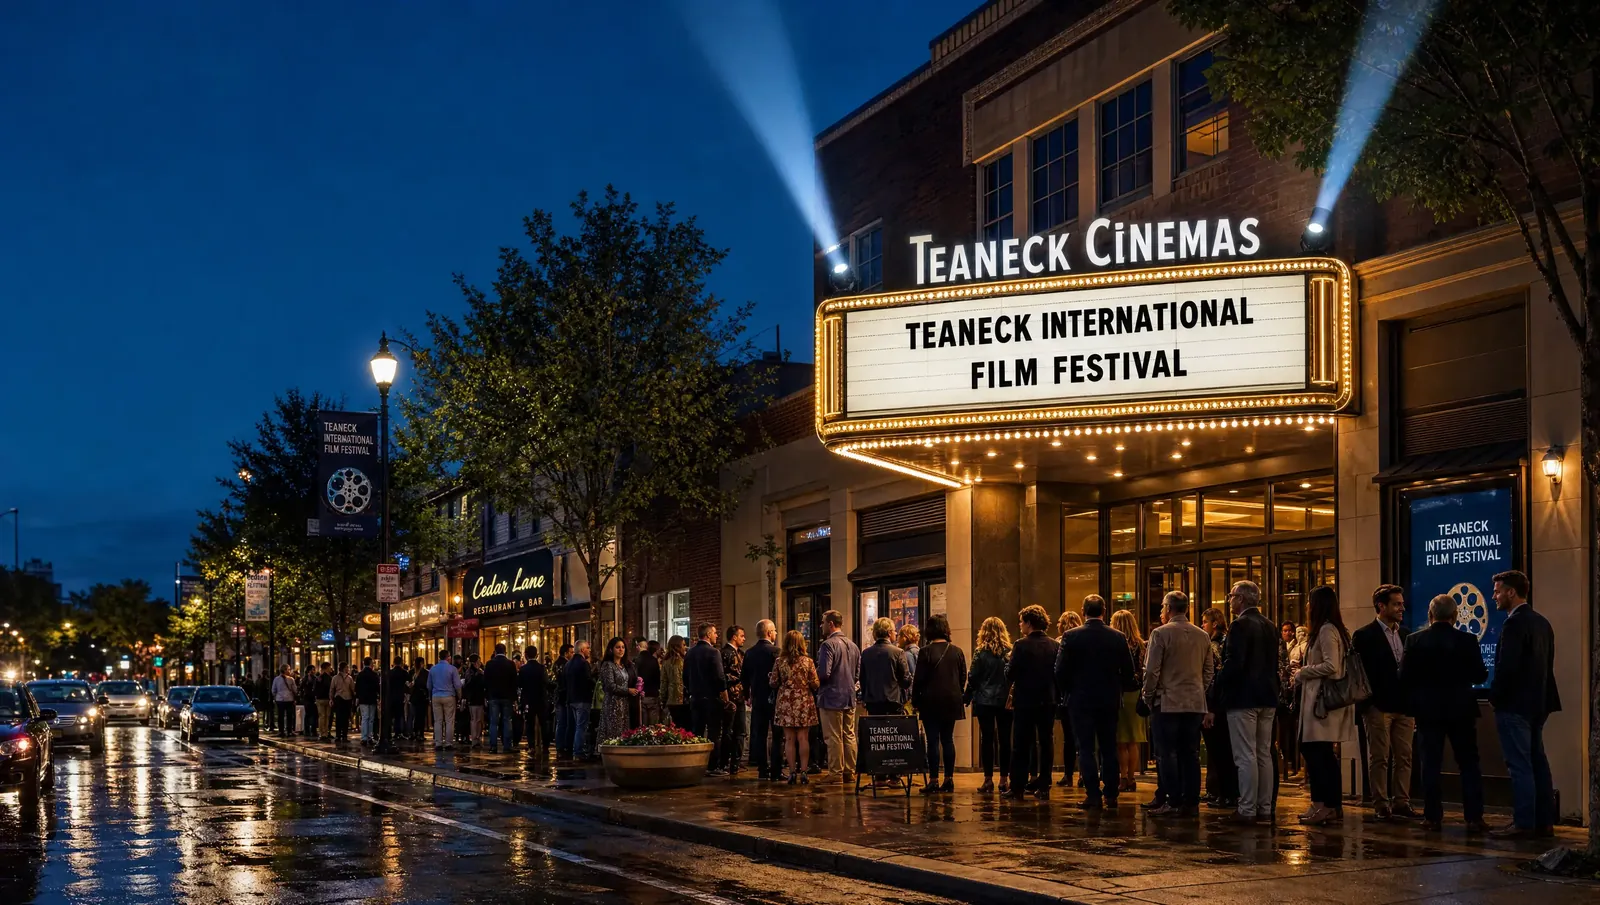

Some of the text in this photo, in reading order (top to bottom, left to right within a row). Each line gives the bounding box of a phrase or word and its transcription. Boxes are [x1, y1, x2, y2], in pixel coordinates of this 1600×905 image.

[909, 233, 1072, 285] TEANECK
[906, 297, 1254, 349] TEANECK INTERNATIONAL
[971, 349, 1187, 389] FILM FESTIVAL
[324, 422, 357, 433] TEANECK
[324, 434, 373, 445] INTERNATIONAL
[324, 445, 370, 455] FILM FESTIVAL
[1438, 520, 1489, 536] TEANECK
[1425, 534, 1501, 552] INTERNATIONAL
[1426, 549, 1501, 566] FILM FESTIVAL
[472, 567, 545, 600] Cedar Lane
[473, 597, 543, 615] RESTAURANT & BAR
[869, 734, 914, 742] INTERNATIONAL
[871, 742, 913, 751] FILM FESTIVAL
